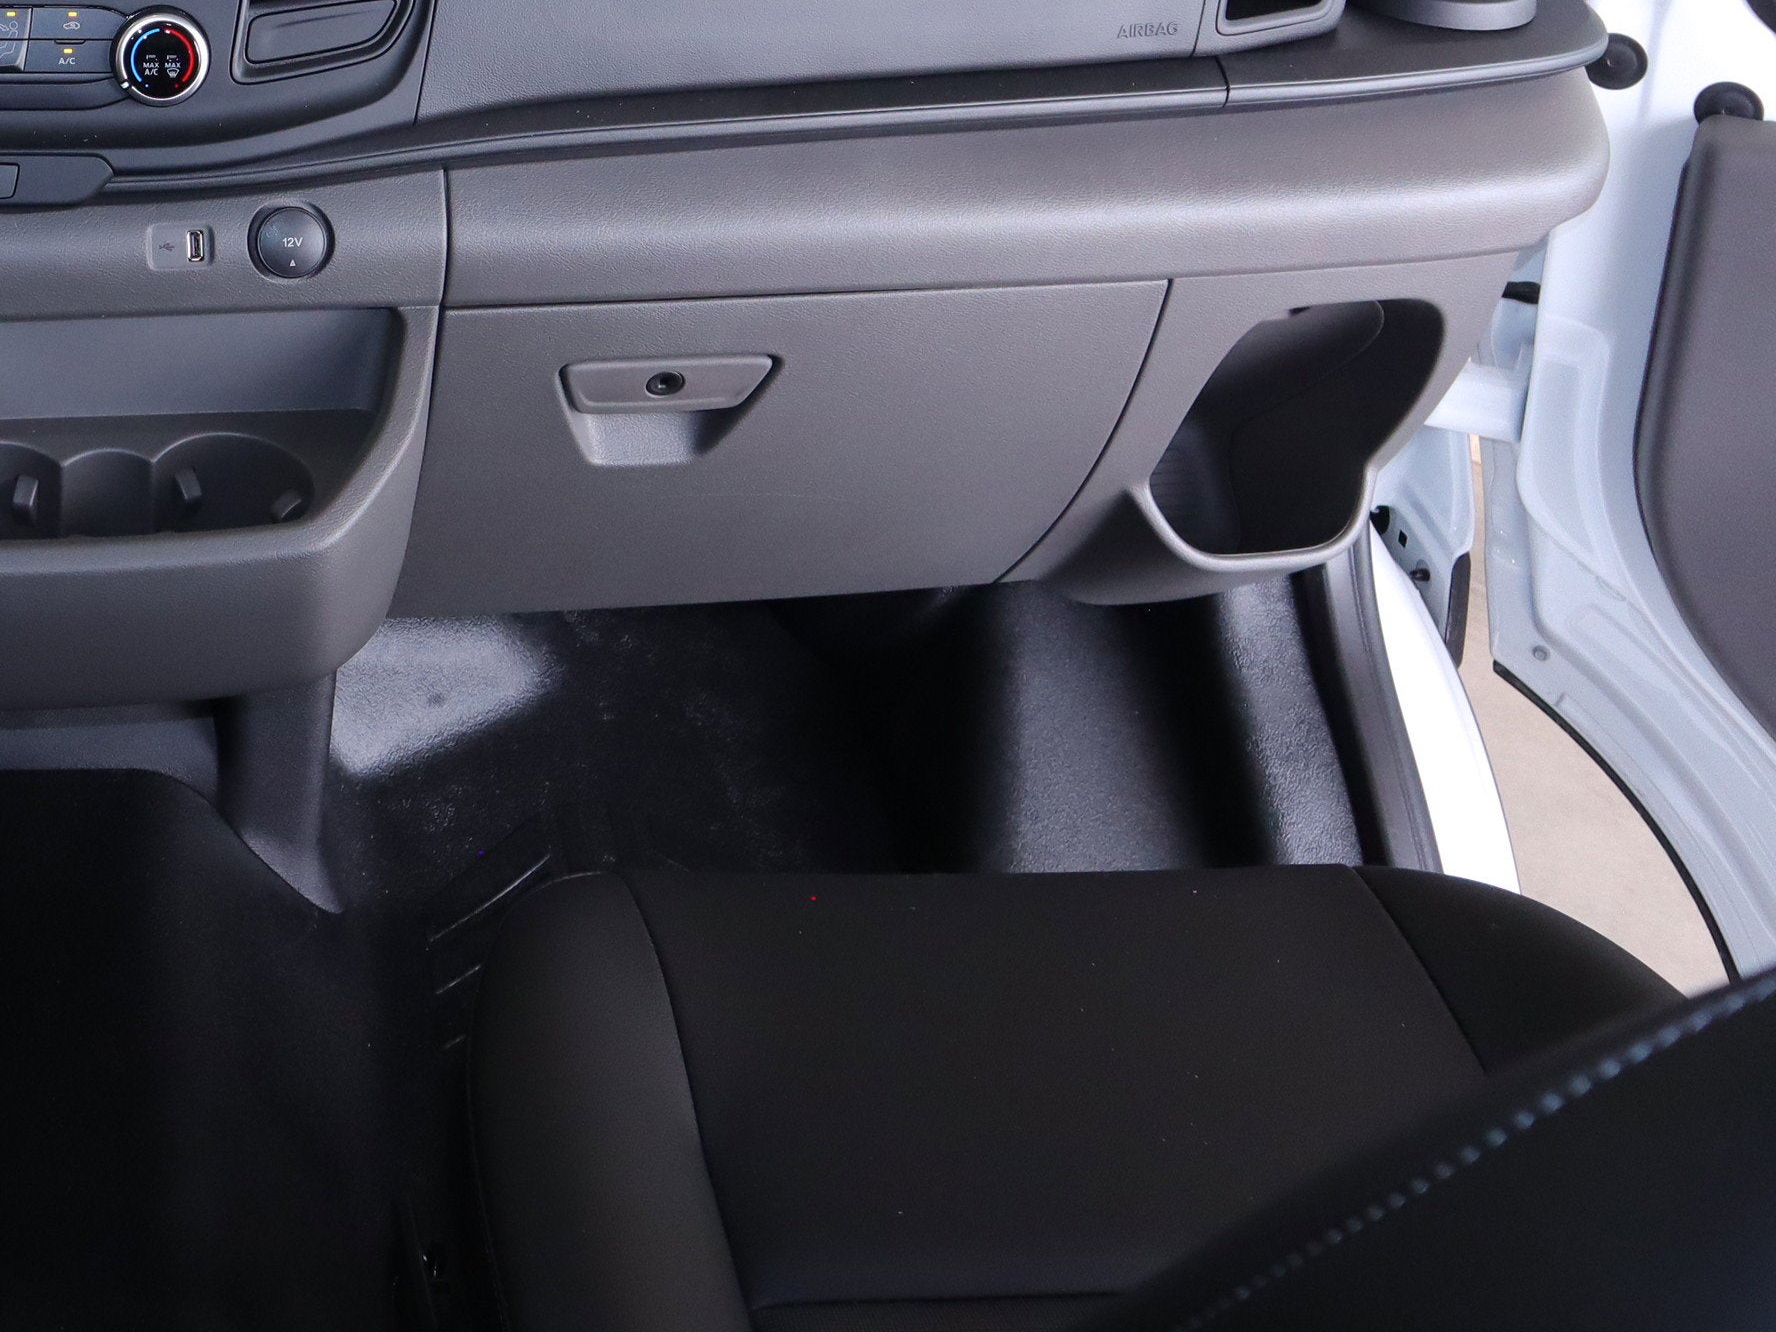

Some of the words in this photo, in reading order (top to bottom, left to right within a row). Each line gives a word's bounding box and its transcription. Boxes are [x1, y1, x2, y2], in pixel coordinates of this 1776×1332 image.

[1116, 20, 1179, 39] AIRBAG
[58, 57, 76, 65] A/C
[144, 68, 159, 76] A/C
[282, 236, 303, 248] 12V
